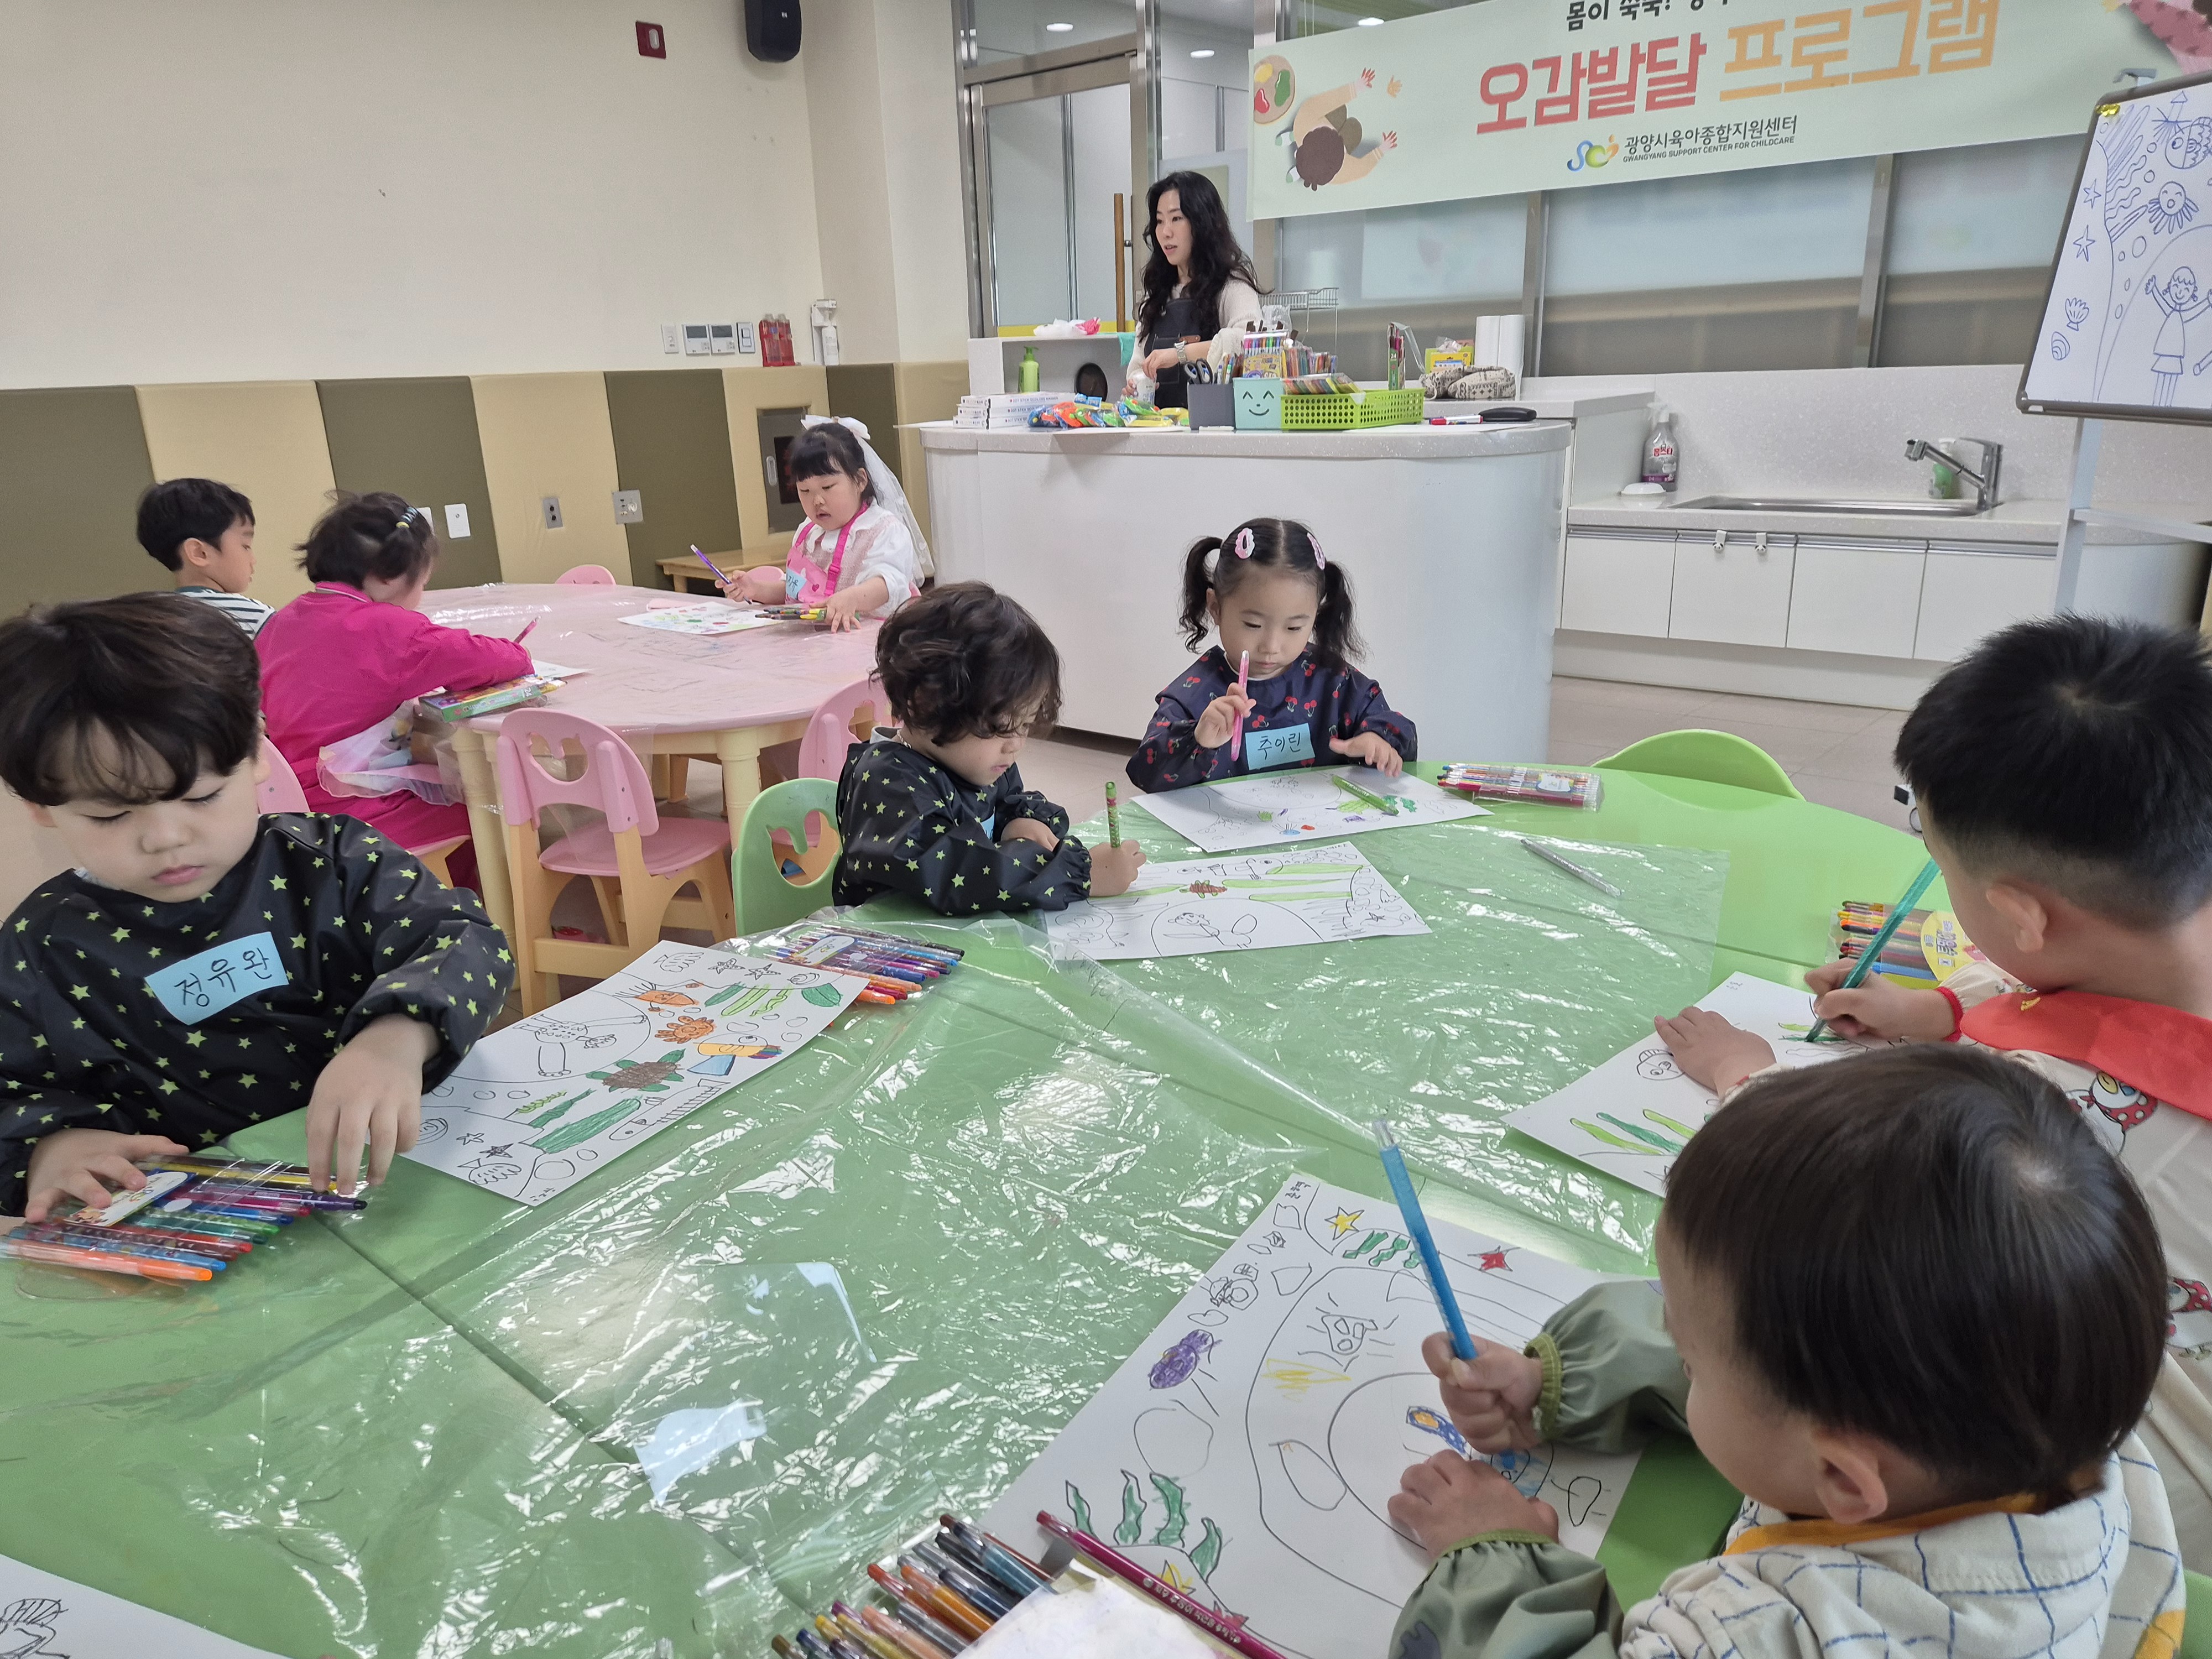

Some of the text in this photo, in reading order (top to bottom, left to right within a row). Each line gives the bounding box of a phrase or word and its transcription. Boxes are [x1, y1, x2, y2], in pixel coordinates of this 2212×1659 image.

[1567, 0, 1609, 32] 몸이
[1477, 0, 2000, 134] 오감발달 프로그램
[1623, 136, 1795, 163] GWANGYANG SUPPORT CENTER FOR CHILDCARE
[1624, 115, 1797, 155] 광양시육아종합지원센터
[1258, 732, 1301, 760] 추이린
[174, 947, 273, 1007] 정유완
